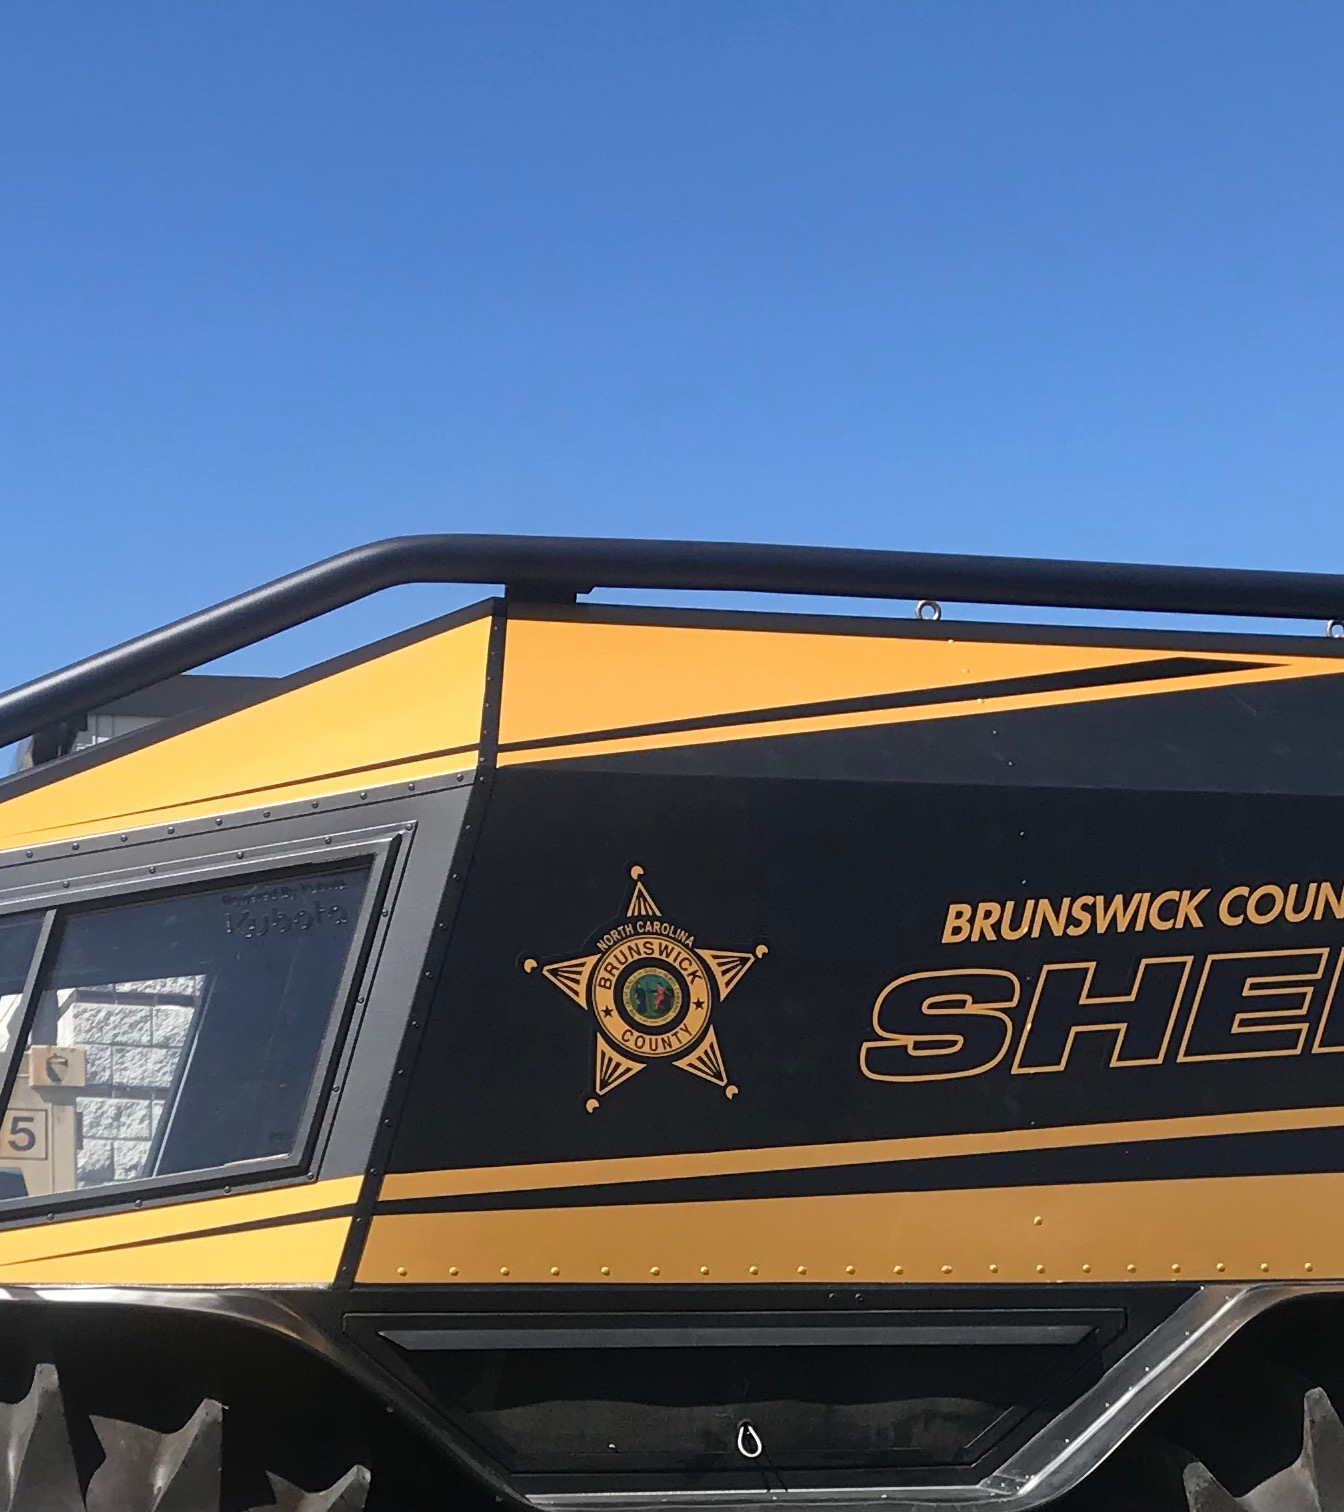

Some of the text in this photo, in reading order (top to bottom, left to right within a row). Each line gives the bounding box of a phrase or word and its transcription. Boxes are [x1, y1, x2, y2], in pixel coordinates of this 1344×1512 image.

[940, 888, 1212, 944] BRUNSWICK
[596, 920, 695, 952] NORTH CAROLINA
[597, 940, 704, 991] BRUNSWICK
[620, 1022, 693, 1052] COUNTY
[7, 1116, 36, 1151] 5
